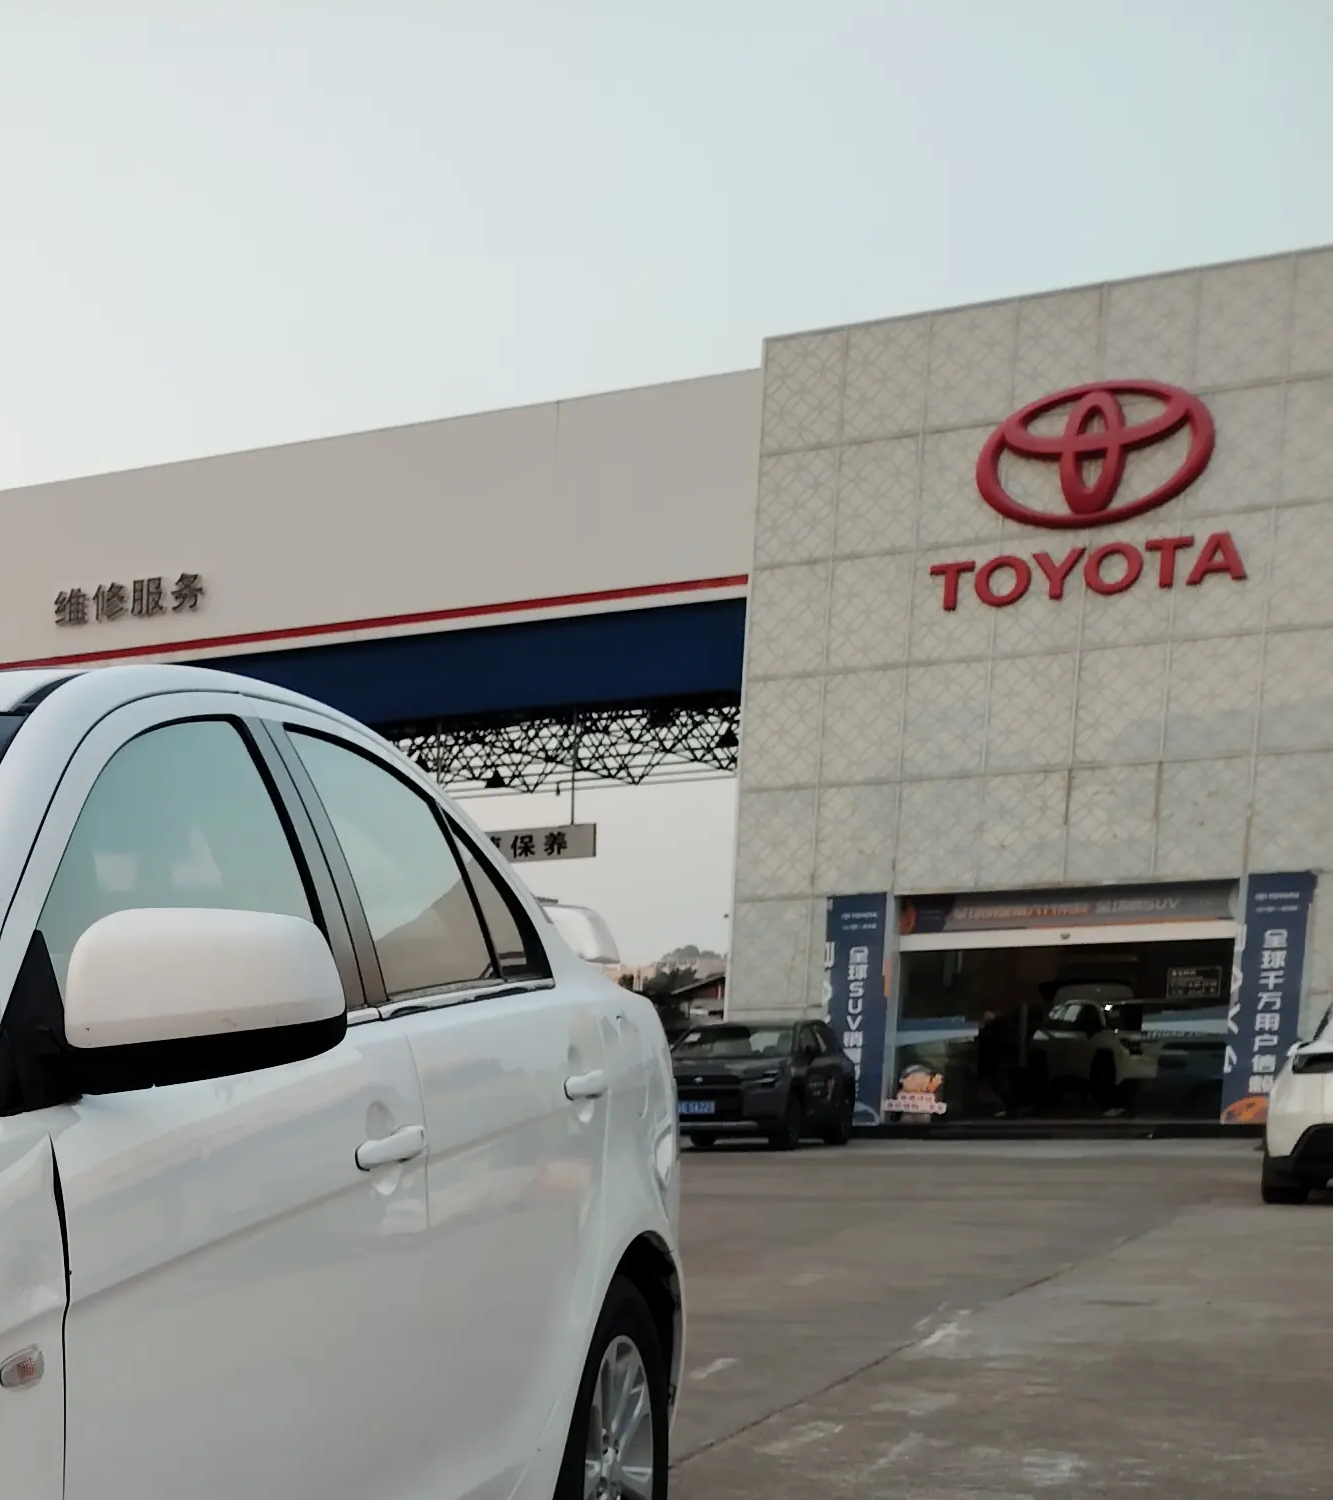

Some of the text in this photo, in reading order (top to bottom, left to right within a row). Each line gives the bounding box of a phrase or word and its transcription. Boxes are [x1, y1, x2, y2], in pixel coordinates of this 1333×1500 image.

[54, 572, 204, 626] 维修服务
[930, 532, 1247, 612] TOYOTA
